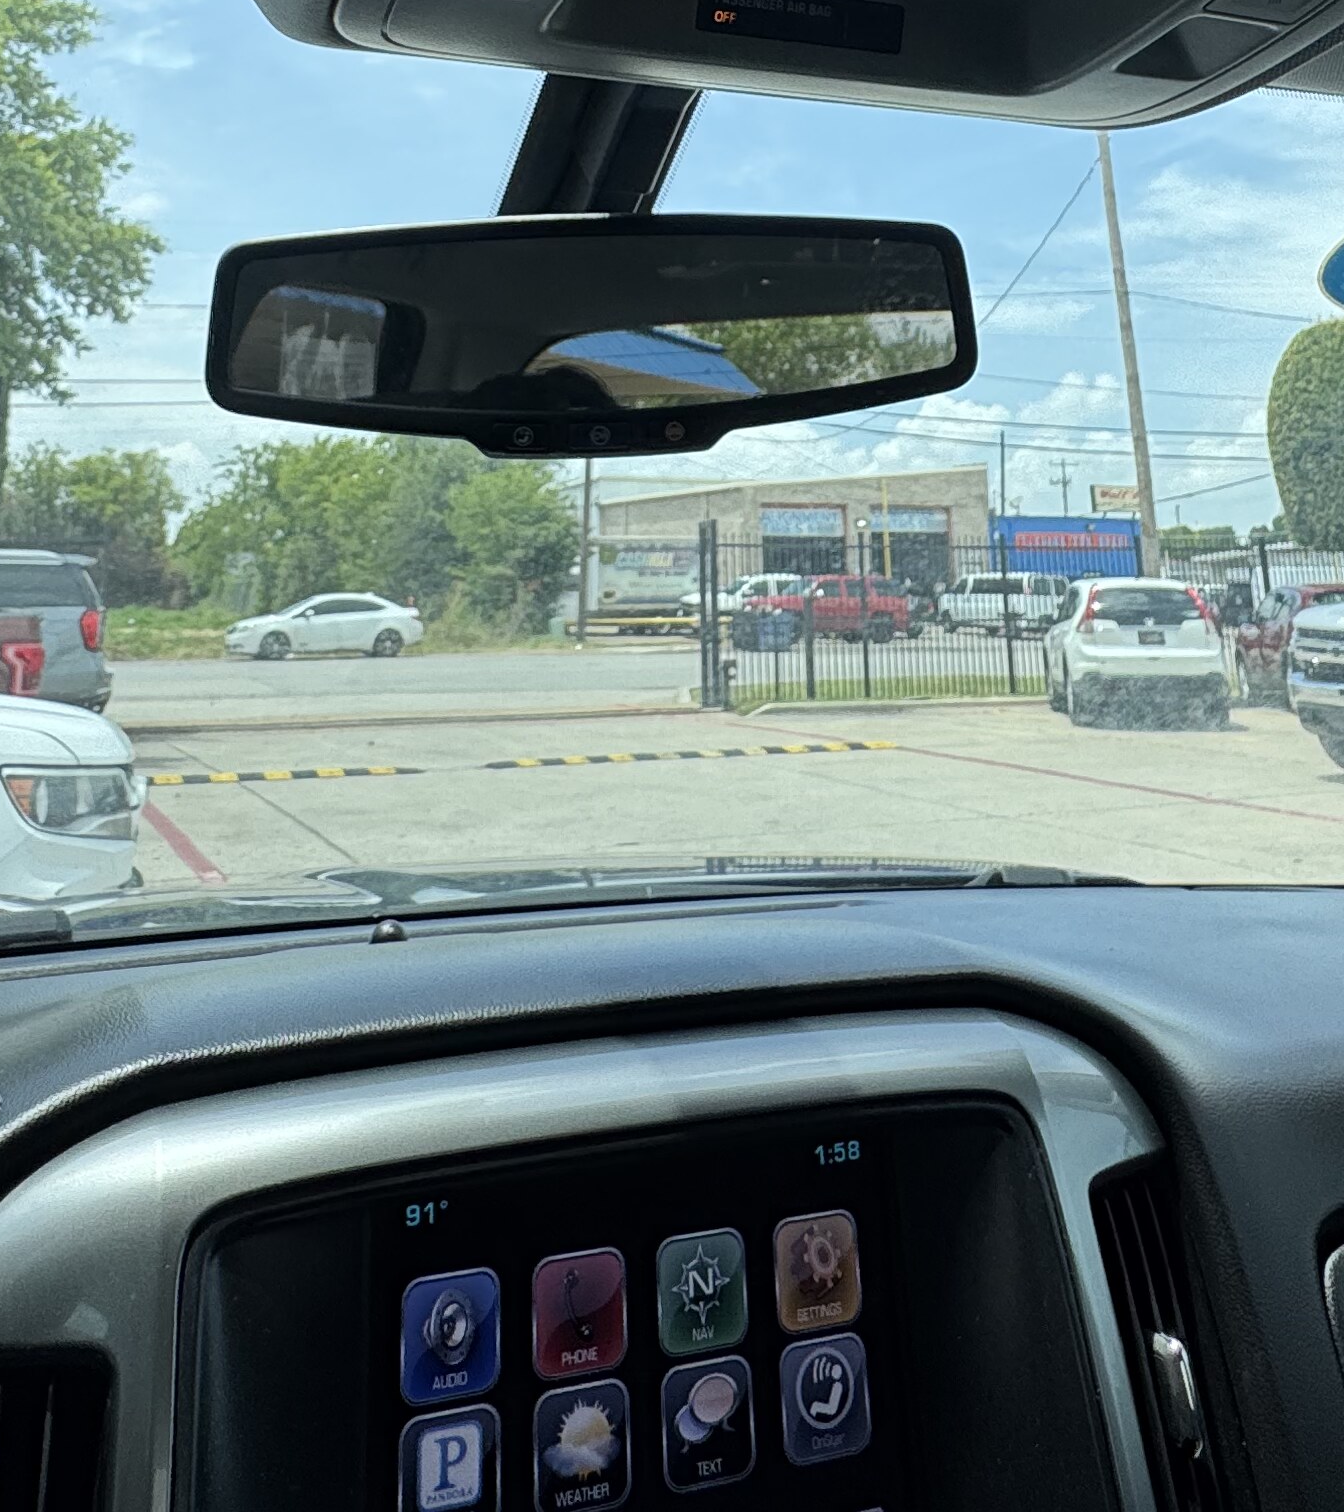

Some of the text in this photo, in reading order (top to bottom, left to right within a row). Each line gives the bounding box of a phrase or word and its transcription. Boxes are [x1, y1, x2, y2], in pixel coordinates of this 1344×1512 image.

[714, 10, 737, 24] OFF
[787, 1, 807, 15] AIR
[809, 4, 832, 17] BAG
[814, 1140, 861, 1165] 1:58
[405, 1199, 449, 1227] 91°
[797, 1302, 843, 1322] SETTINGS
[692, 1326, 714, 1341] NAV
[561, 1346, 598, 1366] PHONE
[432, 1371, 468, 1390] AUDIO
[696, 1458, 723, 1476] TEXT
[555, 1481, 611, 1508] WEATHER
